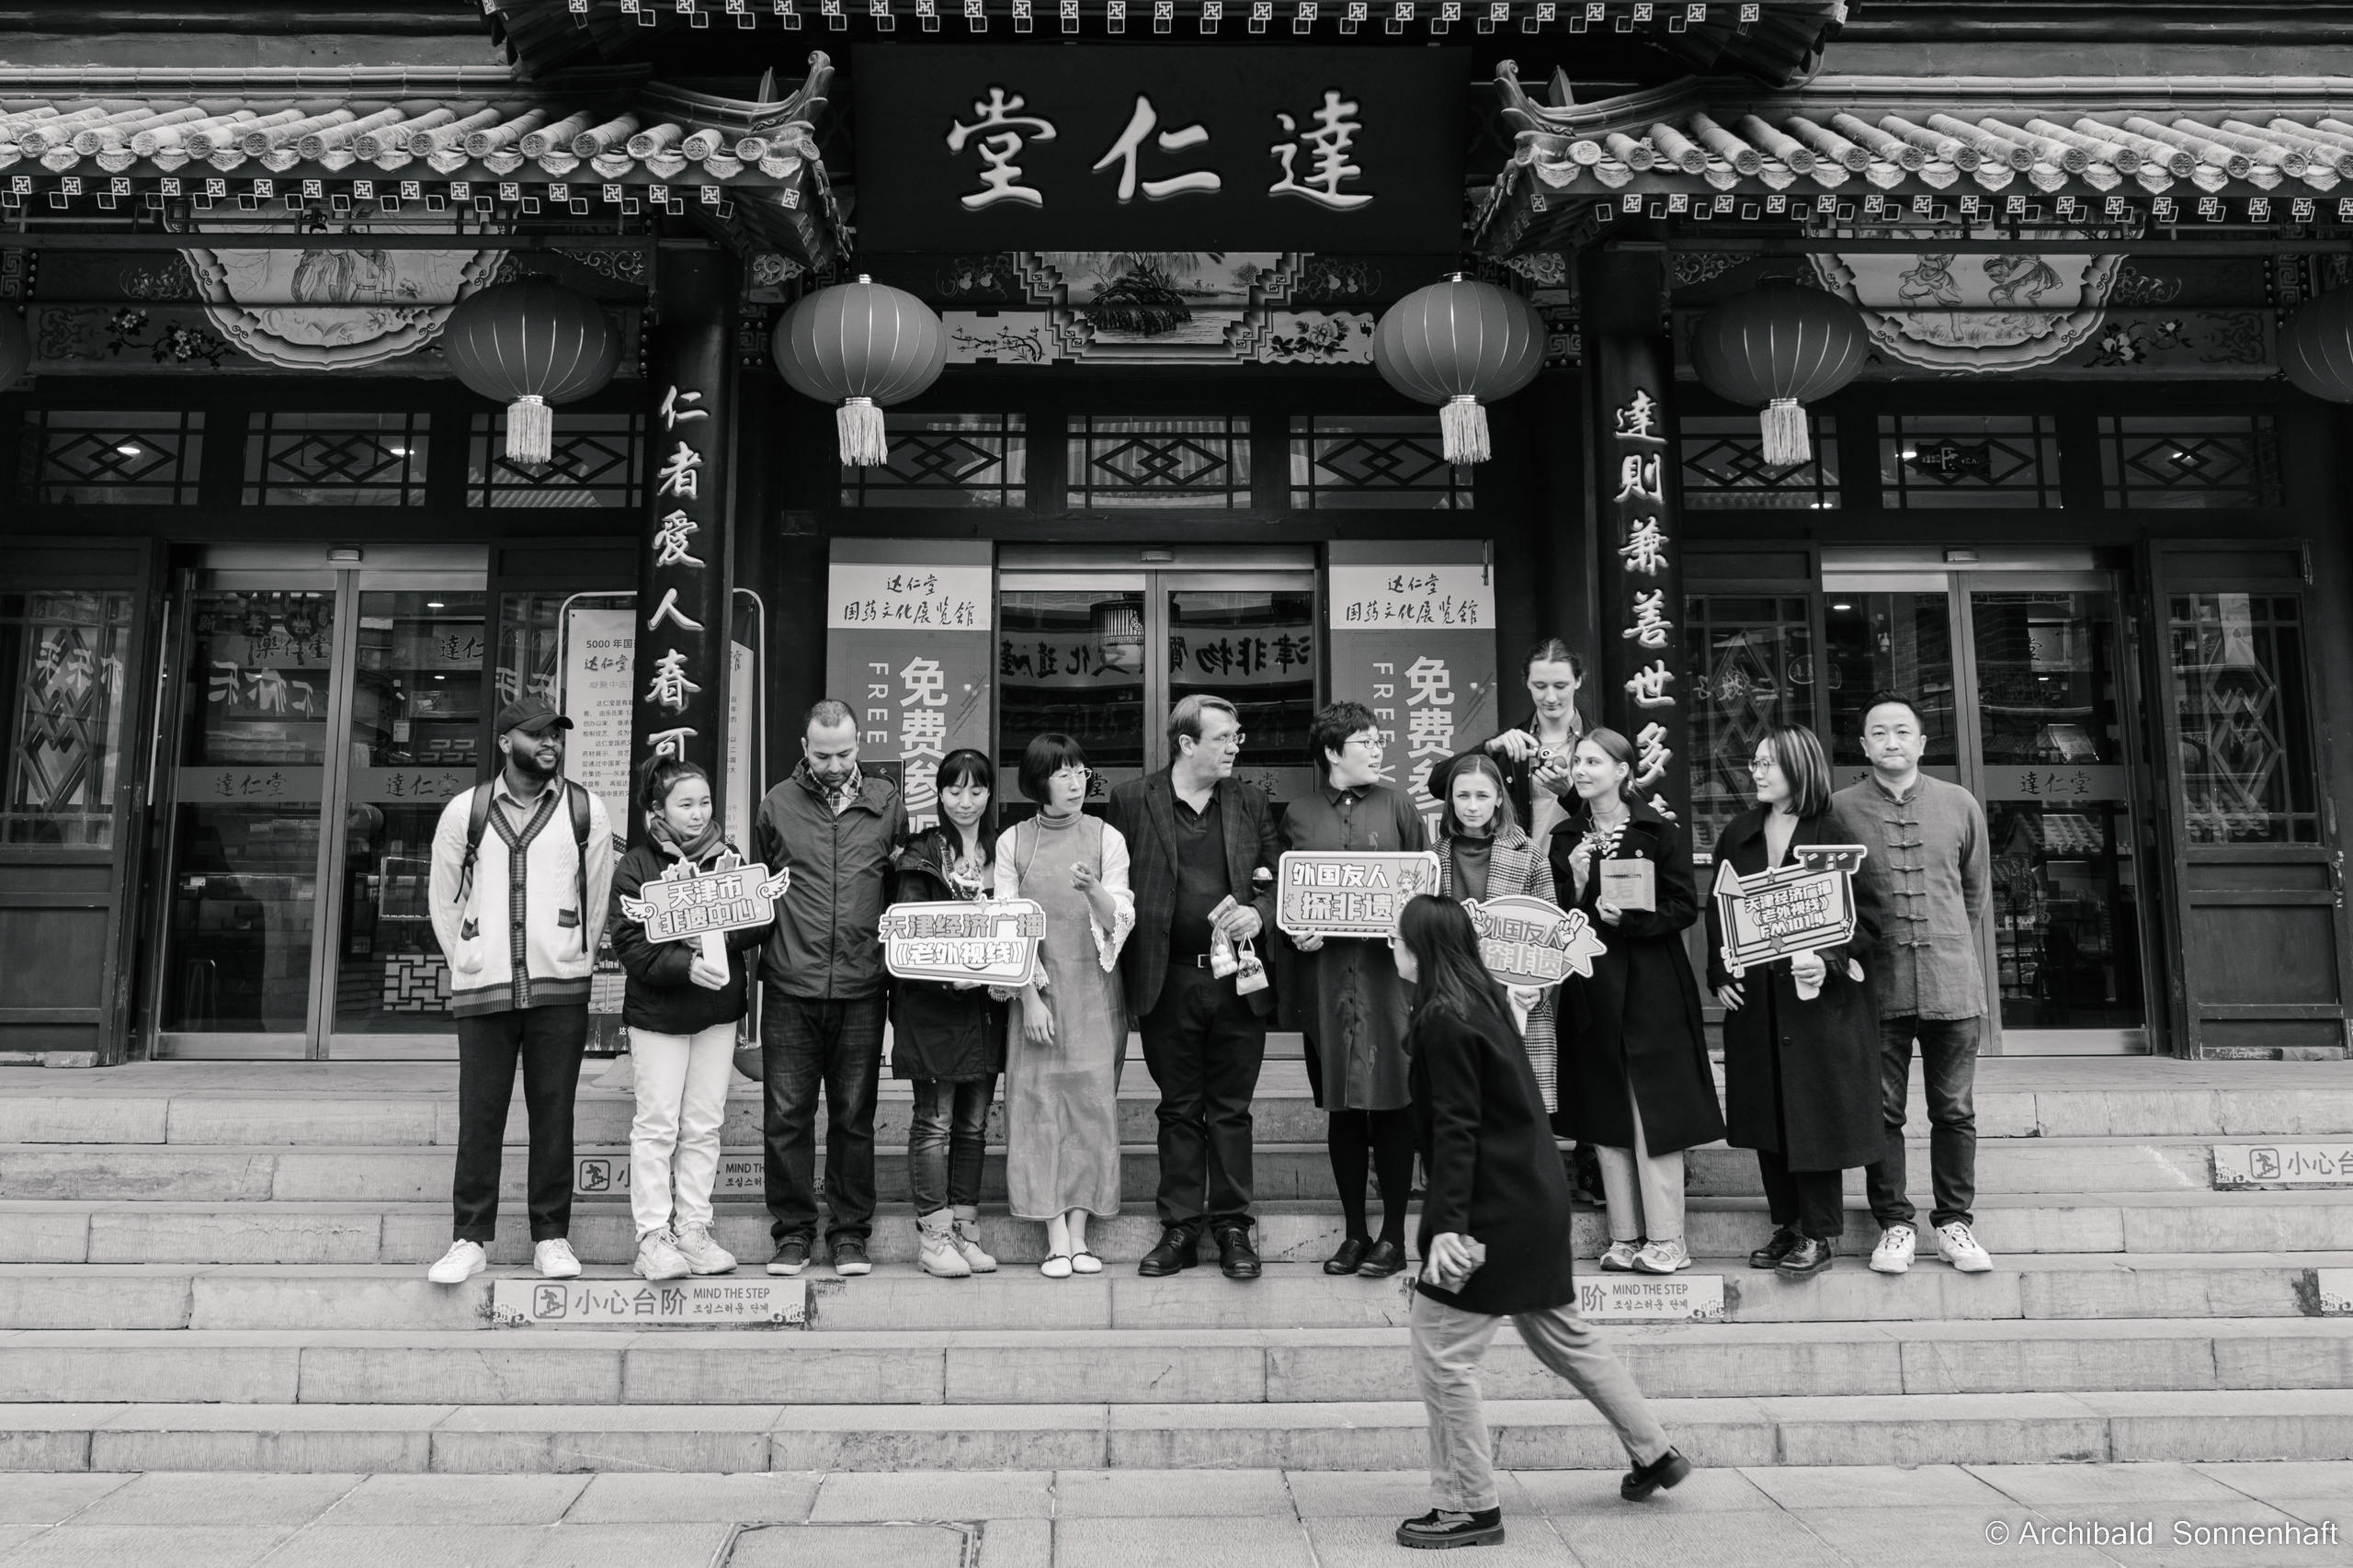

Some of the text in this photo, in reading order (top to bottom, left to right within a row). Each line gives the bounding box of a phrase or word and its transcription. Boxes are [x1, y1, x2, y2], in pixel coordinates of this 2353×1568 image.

[887, 574, 938, 596] 达仁堂
[1388, 574, 1439, 596] 达仁堂
[613, 639, 635, 648] 年国
[585, 654, 634, 672] 达仁堂
[867, 663, 889, 744] FREE
[1291, 862, 1390, 888] 外国友人
[667, 874, 743, 909] 天津市
[1745, 879, 1833, 914] 天津经济广播
[659, 898, 756, 934] 非遗中心
[1302, 891, 1393, 922] 探非遗
[881, 914, 1044, 939] 天津经济广播
[1481, 914, 1564, 949] 外国友人
[1759, 911, 1826, 939] FM101.4
[896, 942, 1024, 965] 《老外视线》
[1479, 937, 1564, 980] 探非遗
[725, 1163, 752, 1174] MIND
[724, 1177, 766, 1187] 조심스러
[574, 1287, 688, 1315] 小心台阶
[693, 1288, 770, 1299] MIND THE STEP
[1612, 1284, 1688, 1295] MIND THE STEP
[693, 1302, 769, 1314] 조심스러운 단계
